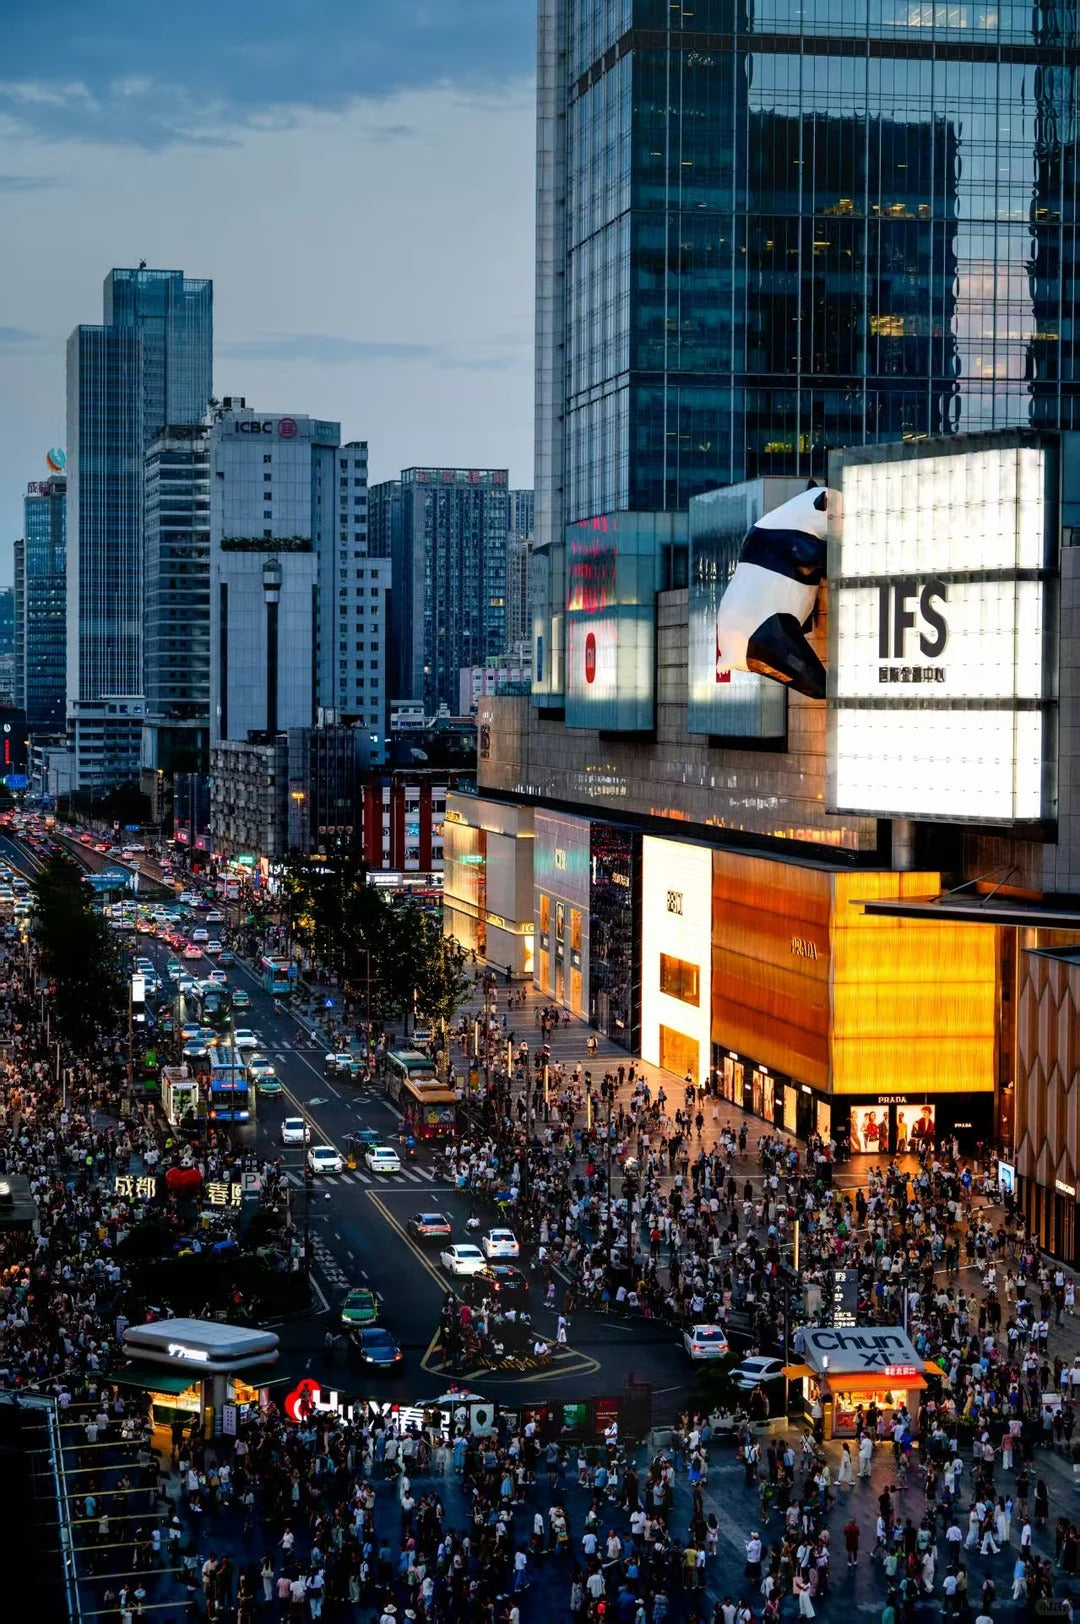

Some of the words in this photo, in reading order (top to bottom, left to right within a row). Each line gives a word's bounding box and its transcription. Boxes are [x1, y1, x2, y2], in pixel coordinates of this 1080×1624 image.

[235, 421, 272, 434] ICBC
[878, 581, 949, 658] IFS
[790, 936, 818, 960] PRADA
[878, 1096, 908, 1104] PRADA
[115, 1176, 156, 1198] 成都
[245, 1174, 256, 1189] P
[811, 1332, 904, 1350] Chun
[859, 1349, 892, 1366] xi
